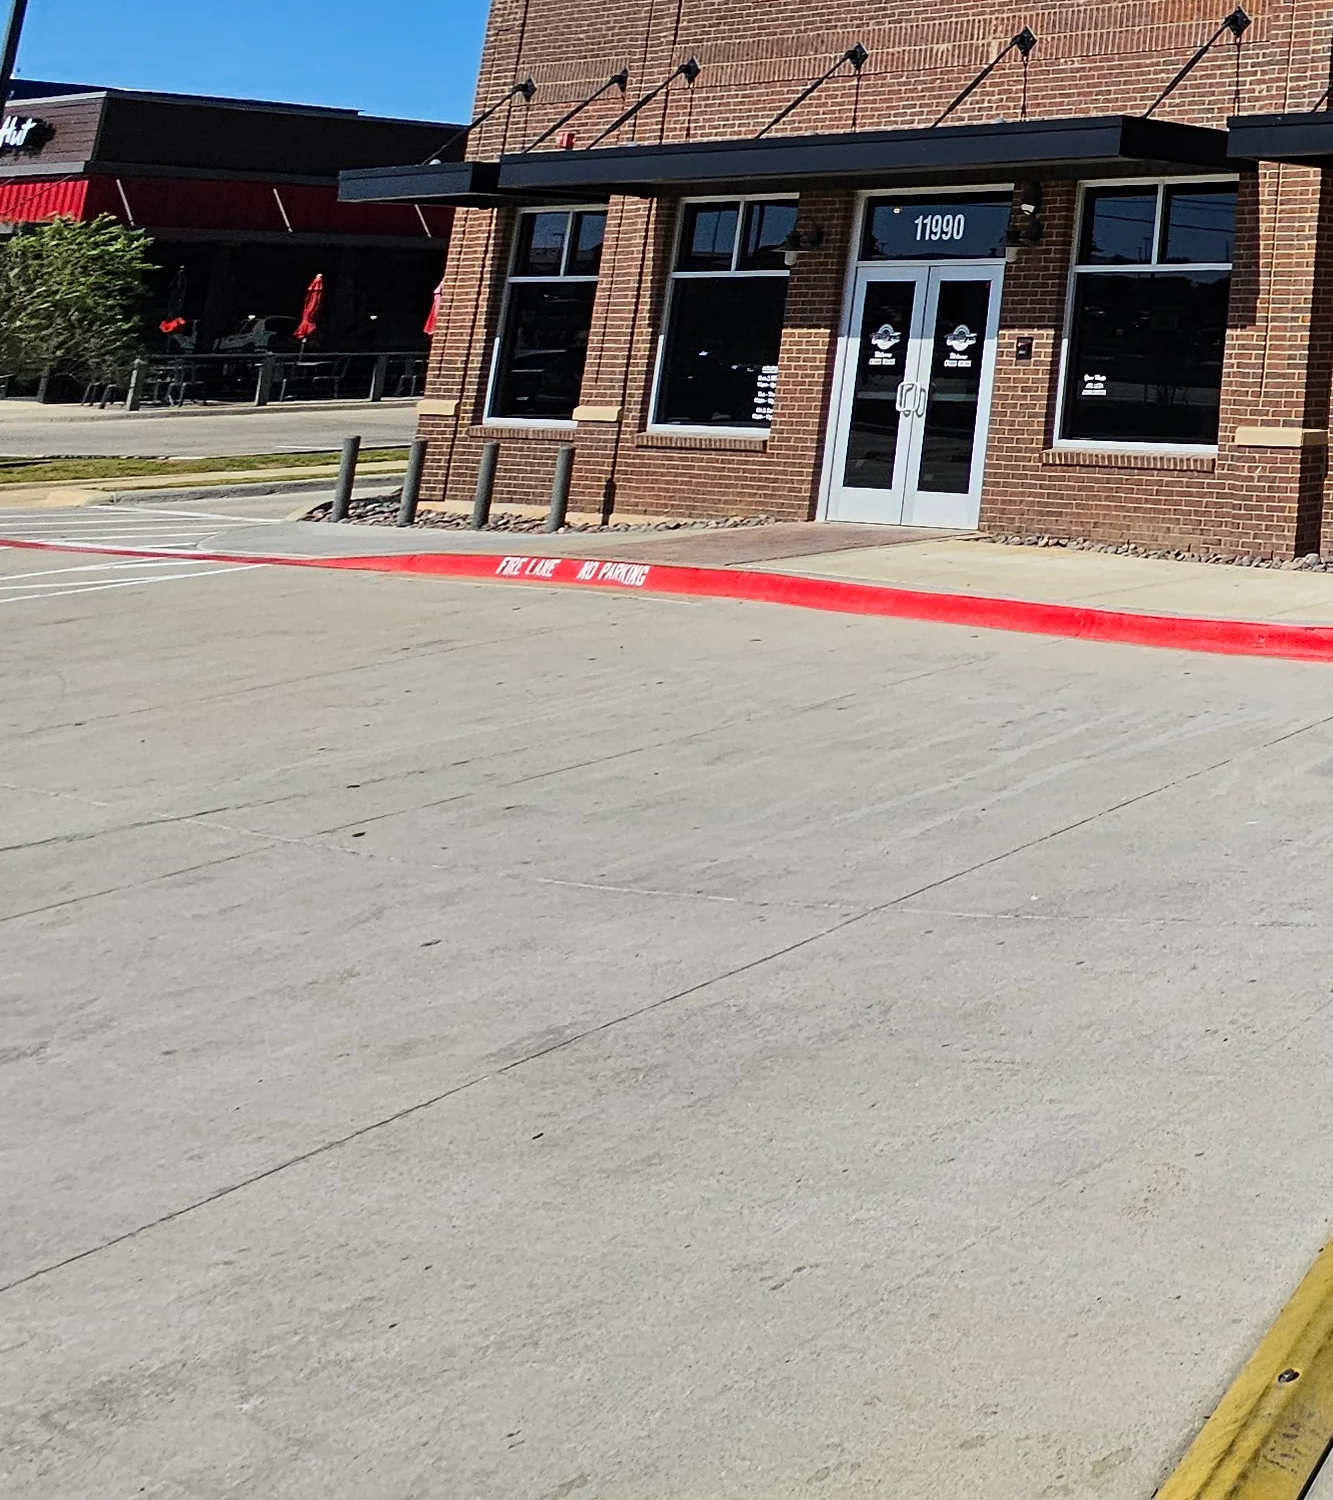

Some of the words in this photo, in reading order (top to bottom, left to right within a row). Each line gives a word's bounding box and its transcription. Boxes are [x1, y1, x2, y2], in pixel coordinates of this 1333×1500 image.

[914, 213, 965, 241] 11990
[495, 556, 529, 576] FIRE
[525, 558, 562, 578] LANE
[576, 560, 600, 580] NO
[597, 562, 651, 587] PARKING
